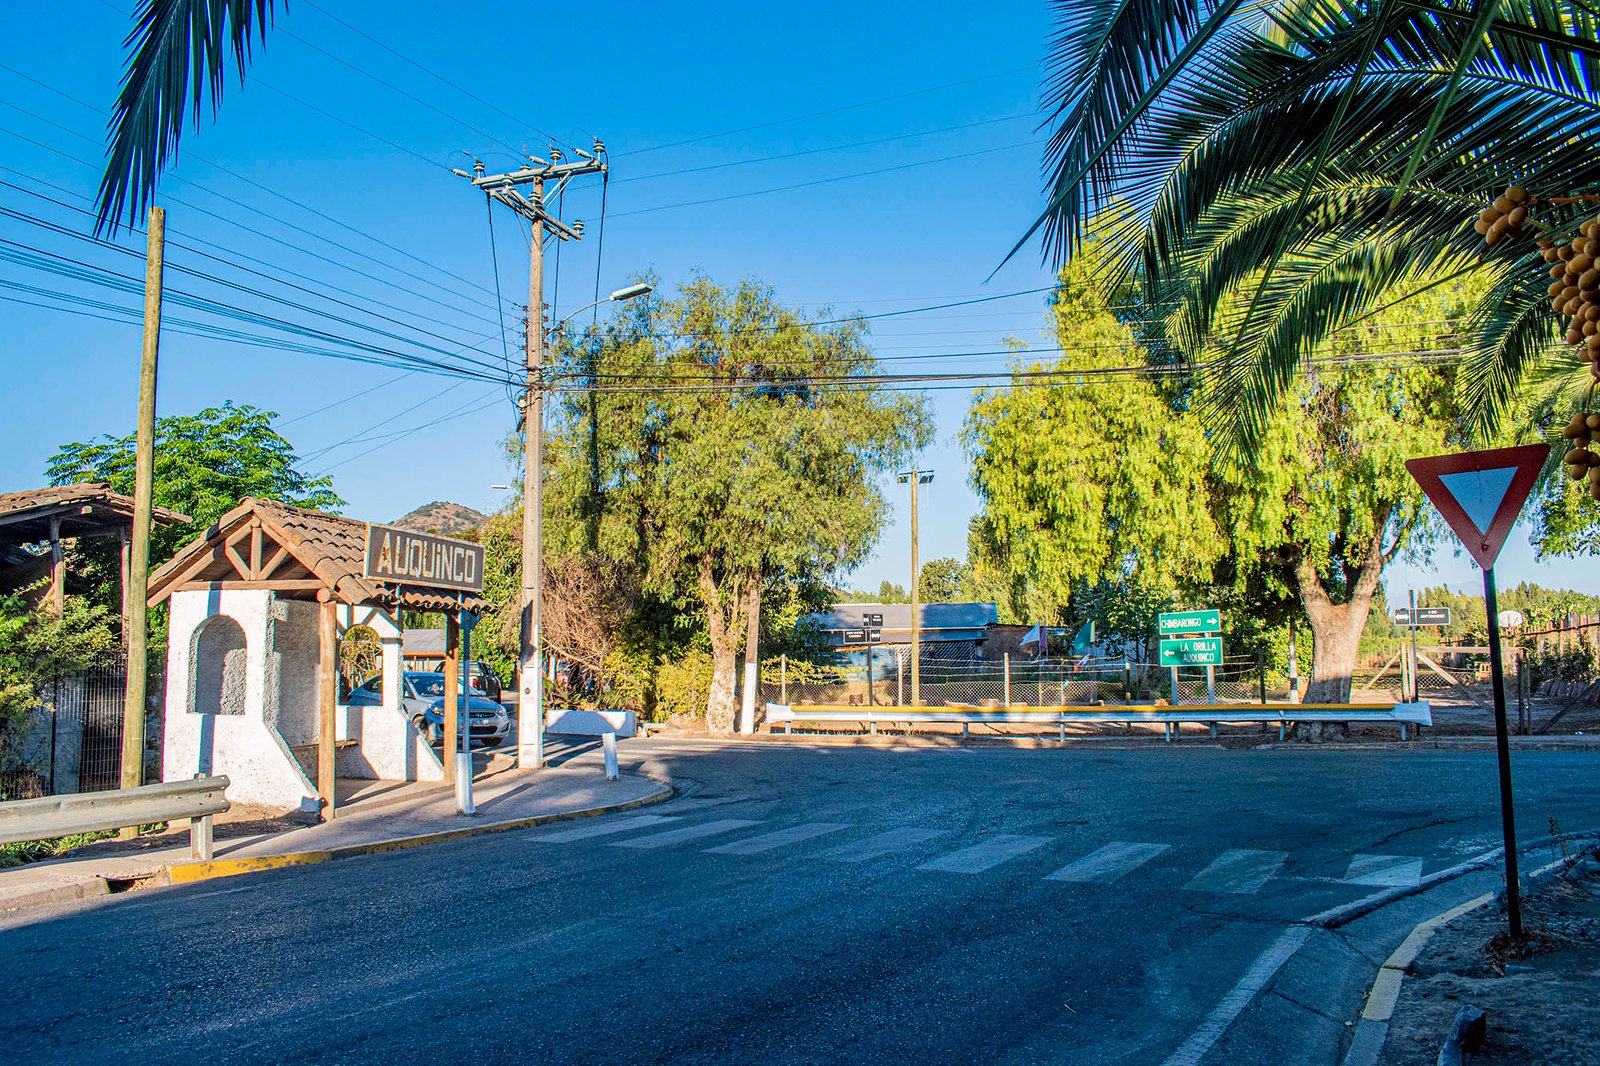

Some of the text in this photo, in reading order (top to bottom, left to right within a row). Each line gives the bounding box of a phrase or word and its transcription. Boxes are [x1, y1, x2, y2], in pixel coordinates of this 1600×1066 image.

[1162, 618, 1202, 629] CHIMBARONGO
[1180, 642, 1216, 652] LA ORILLA
